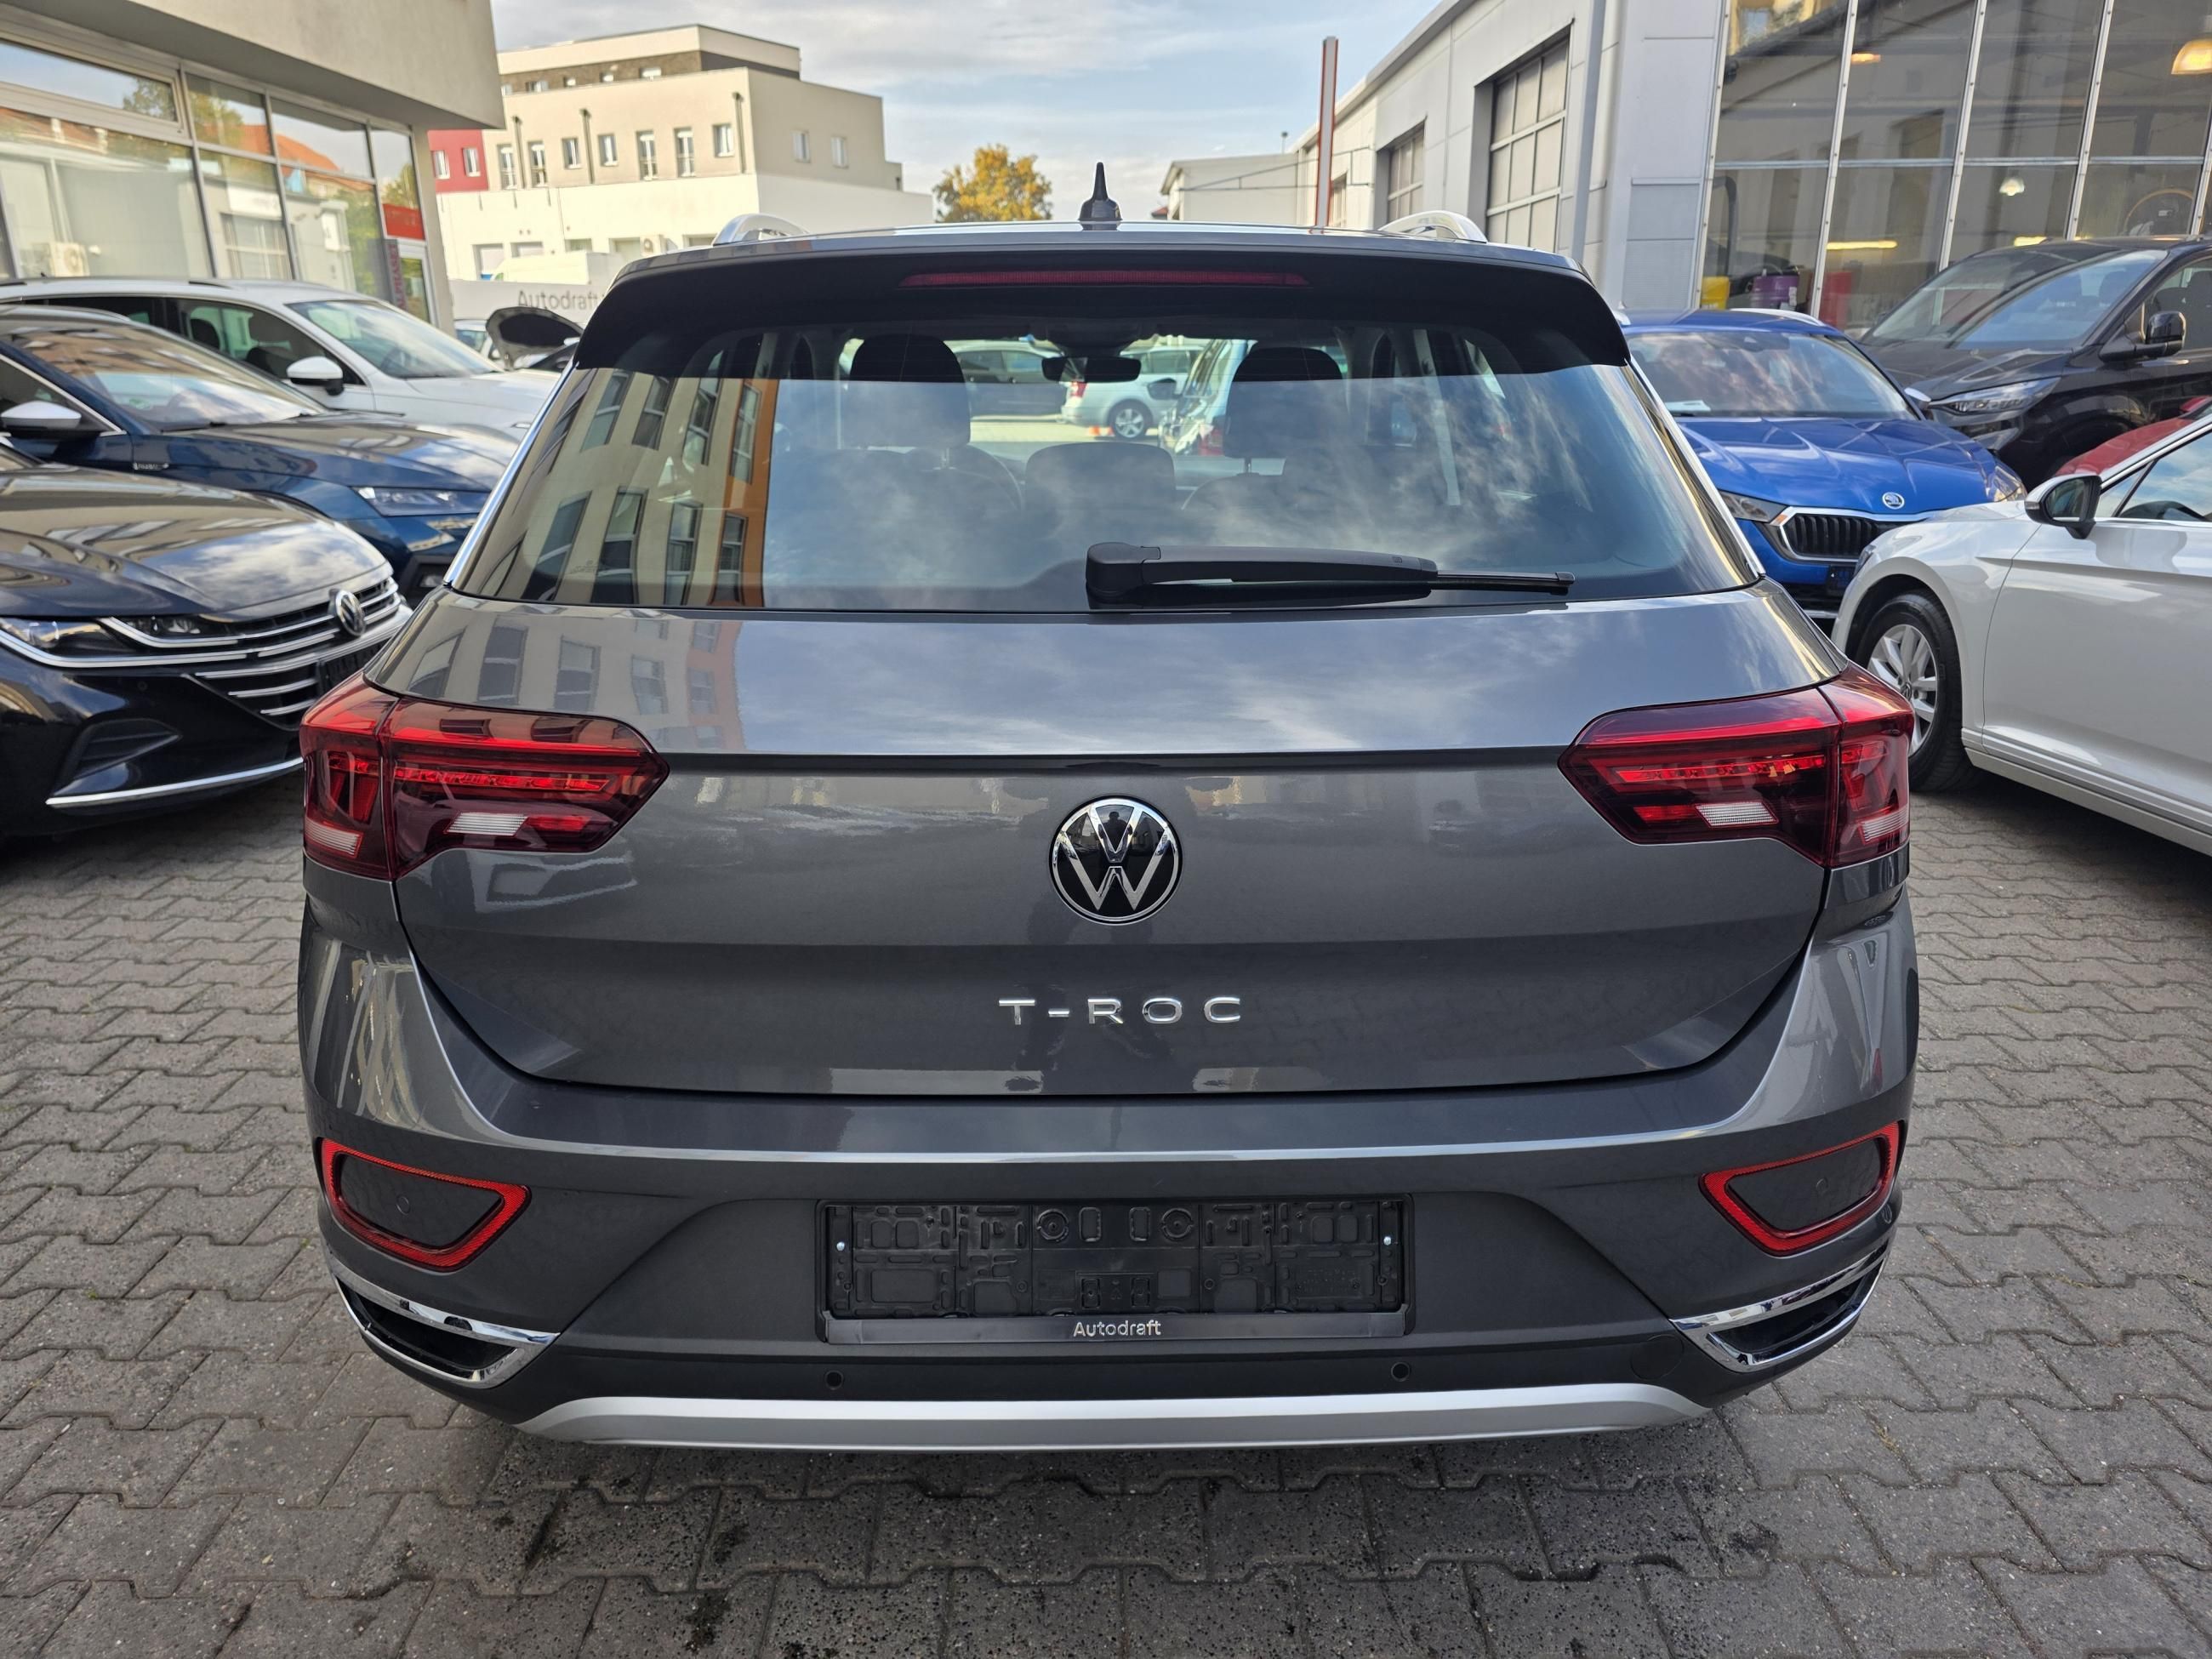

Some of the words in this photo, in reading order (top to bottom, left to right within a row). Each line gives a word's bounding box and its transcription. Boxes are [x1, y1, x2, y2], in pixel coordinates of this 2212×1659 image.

[518, 289, 599, 310] Autodraft
[1052, 797, 1181, 924] VW
[998, 996, 1241, 1025] T-ROC
[1073, 1320, 1162, 1337] Autodraft
